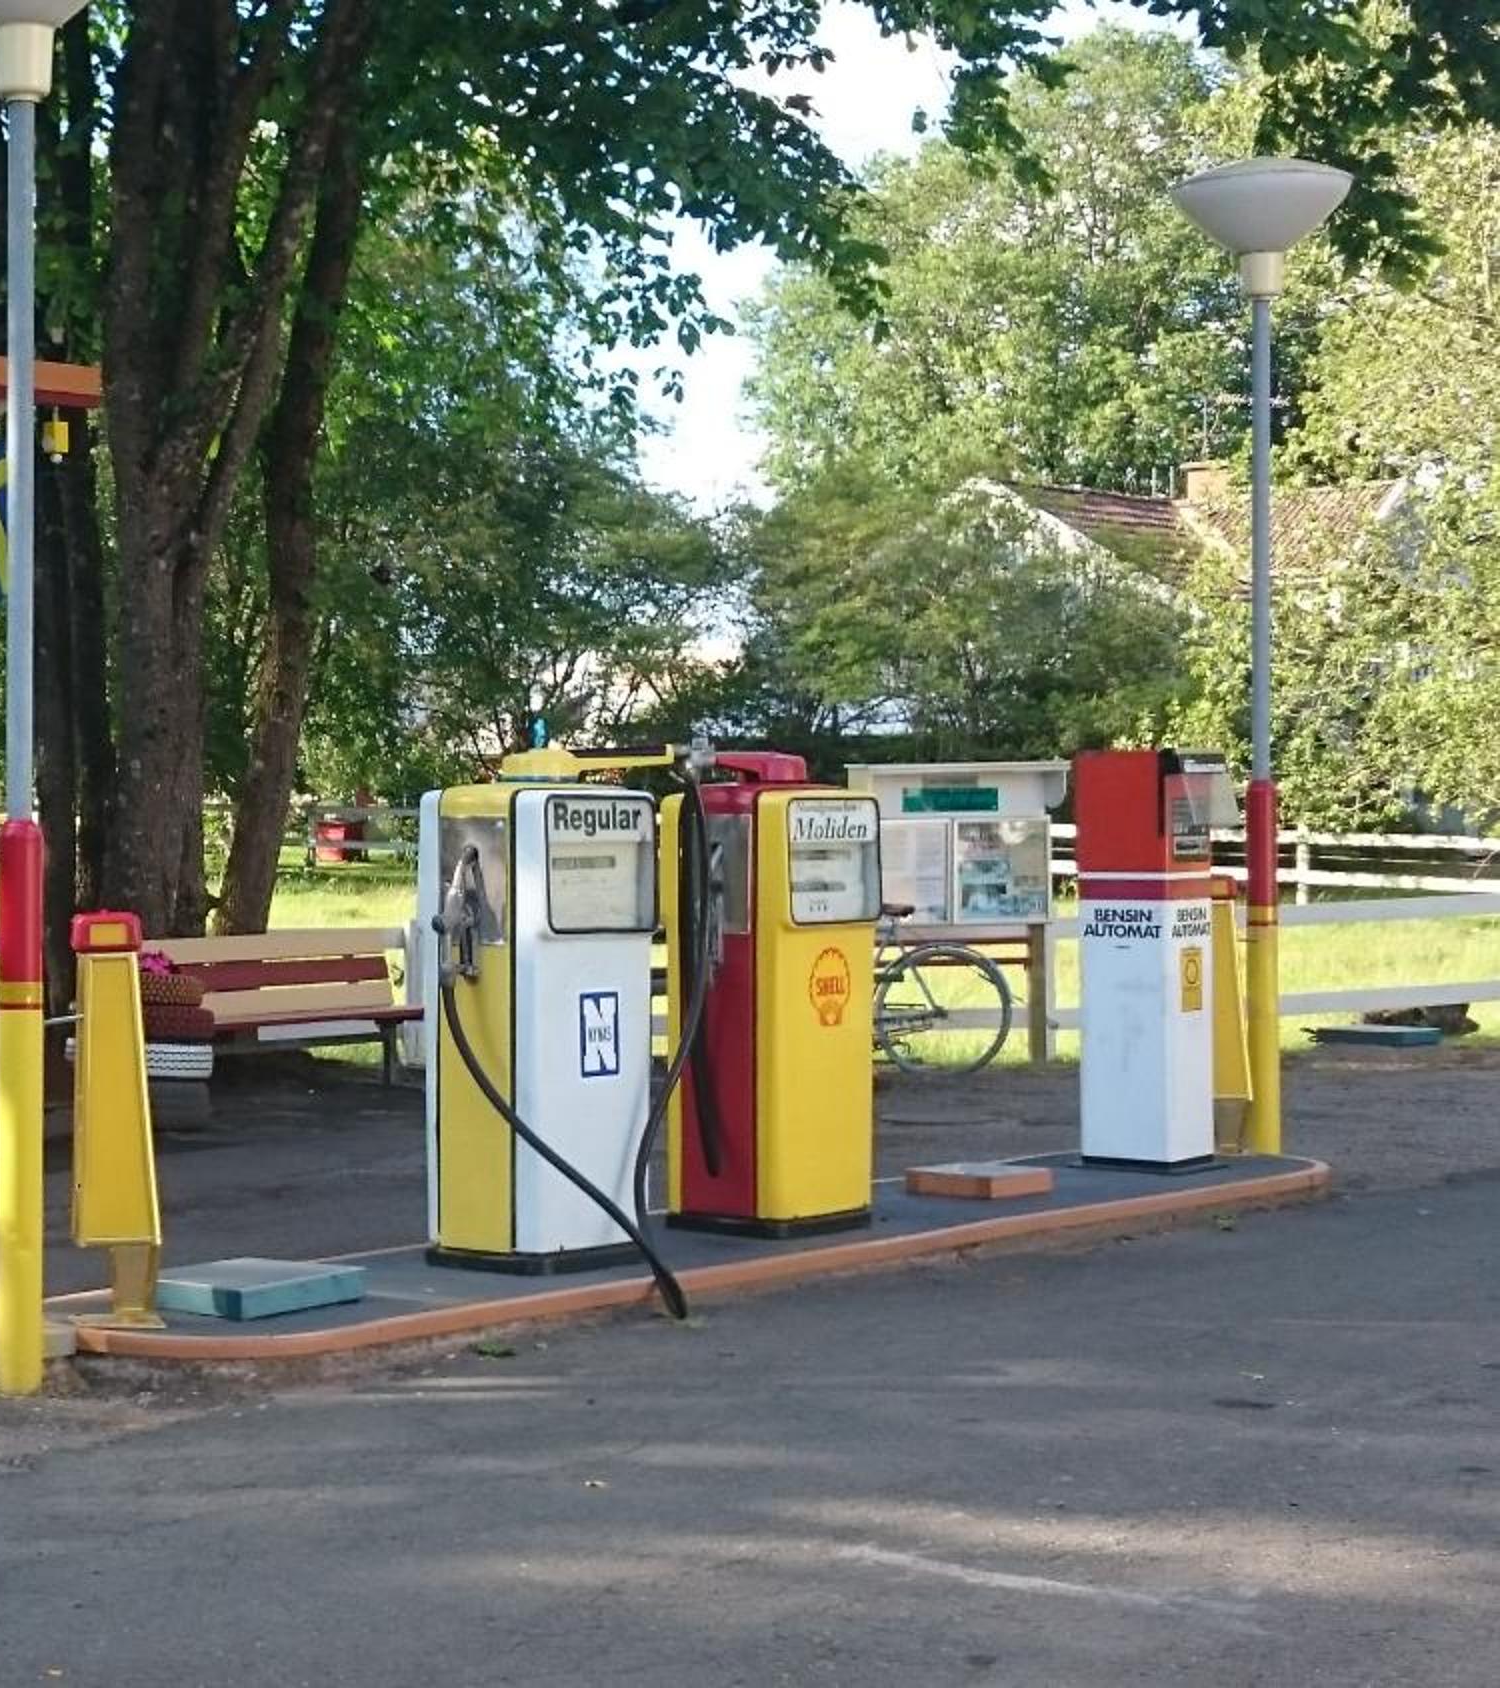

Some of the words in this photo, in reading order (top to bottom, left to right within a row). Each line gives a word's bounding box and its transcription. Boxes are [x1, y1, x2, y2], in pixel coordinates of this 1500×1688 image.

[553, 801, 642, 836] Regular
[793, 815, 868, 841] Moliden
[1093, 908, 1153, 923] BENSIN
[1083, 923, 1163, 939] AUTOMAT
[816, 975, 846, 996] SHELL
